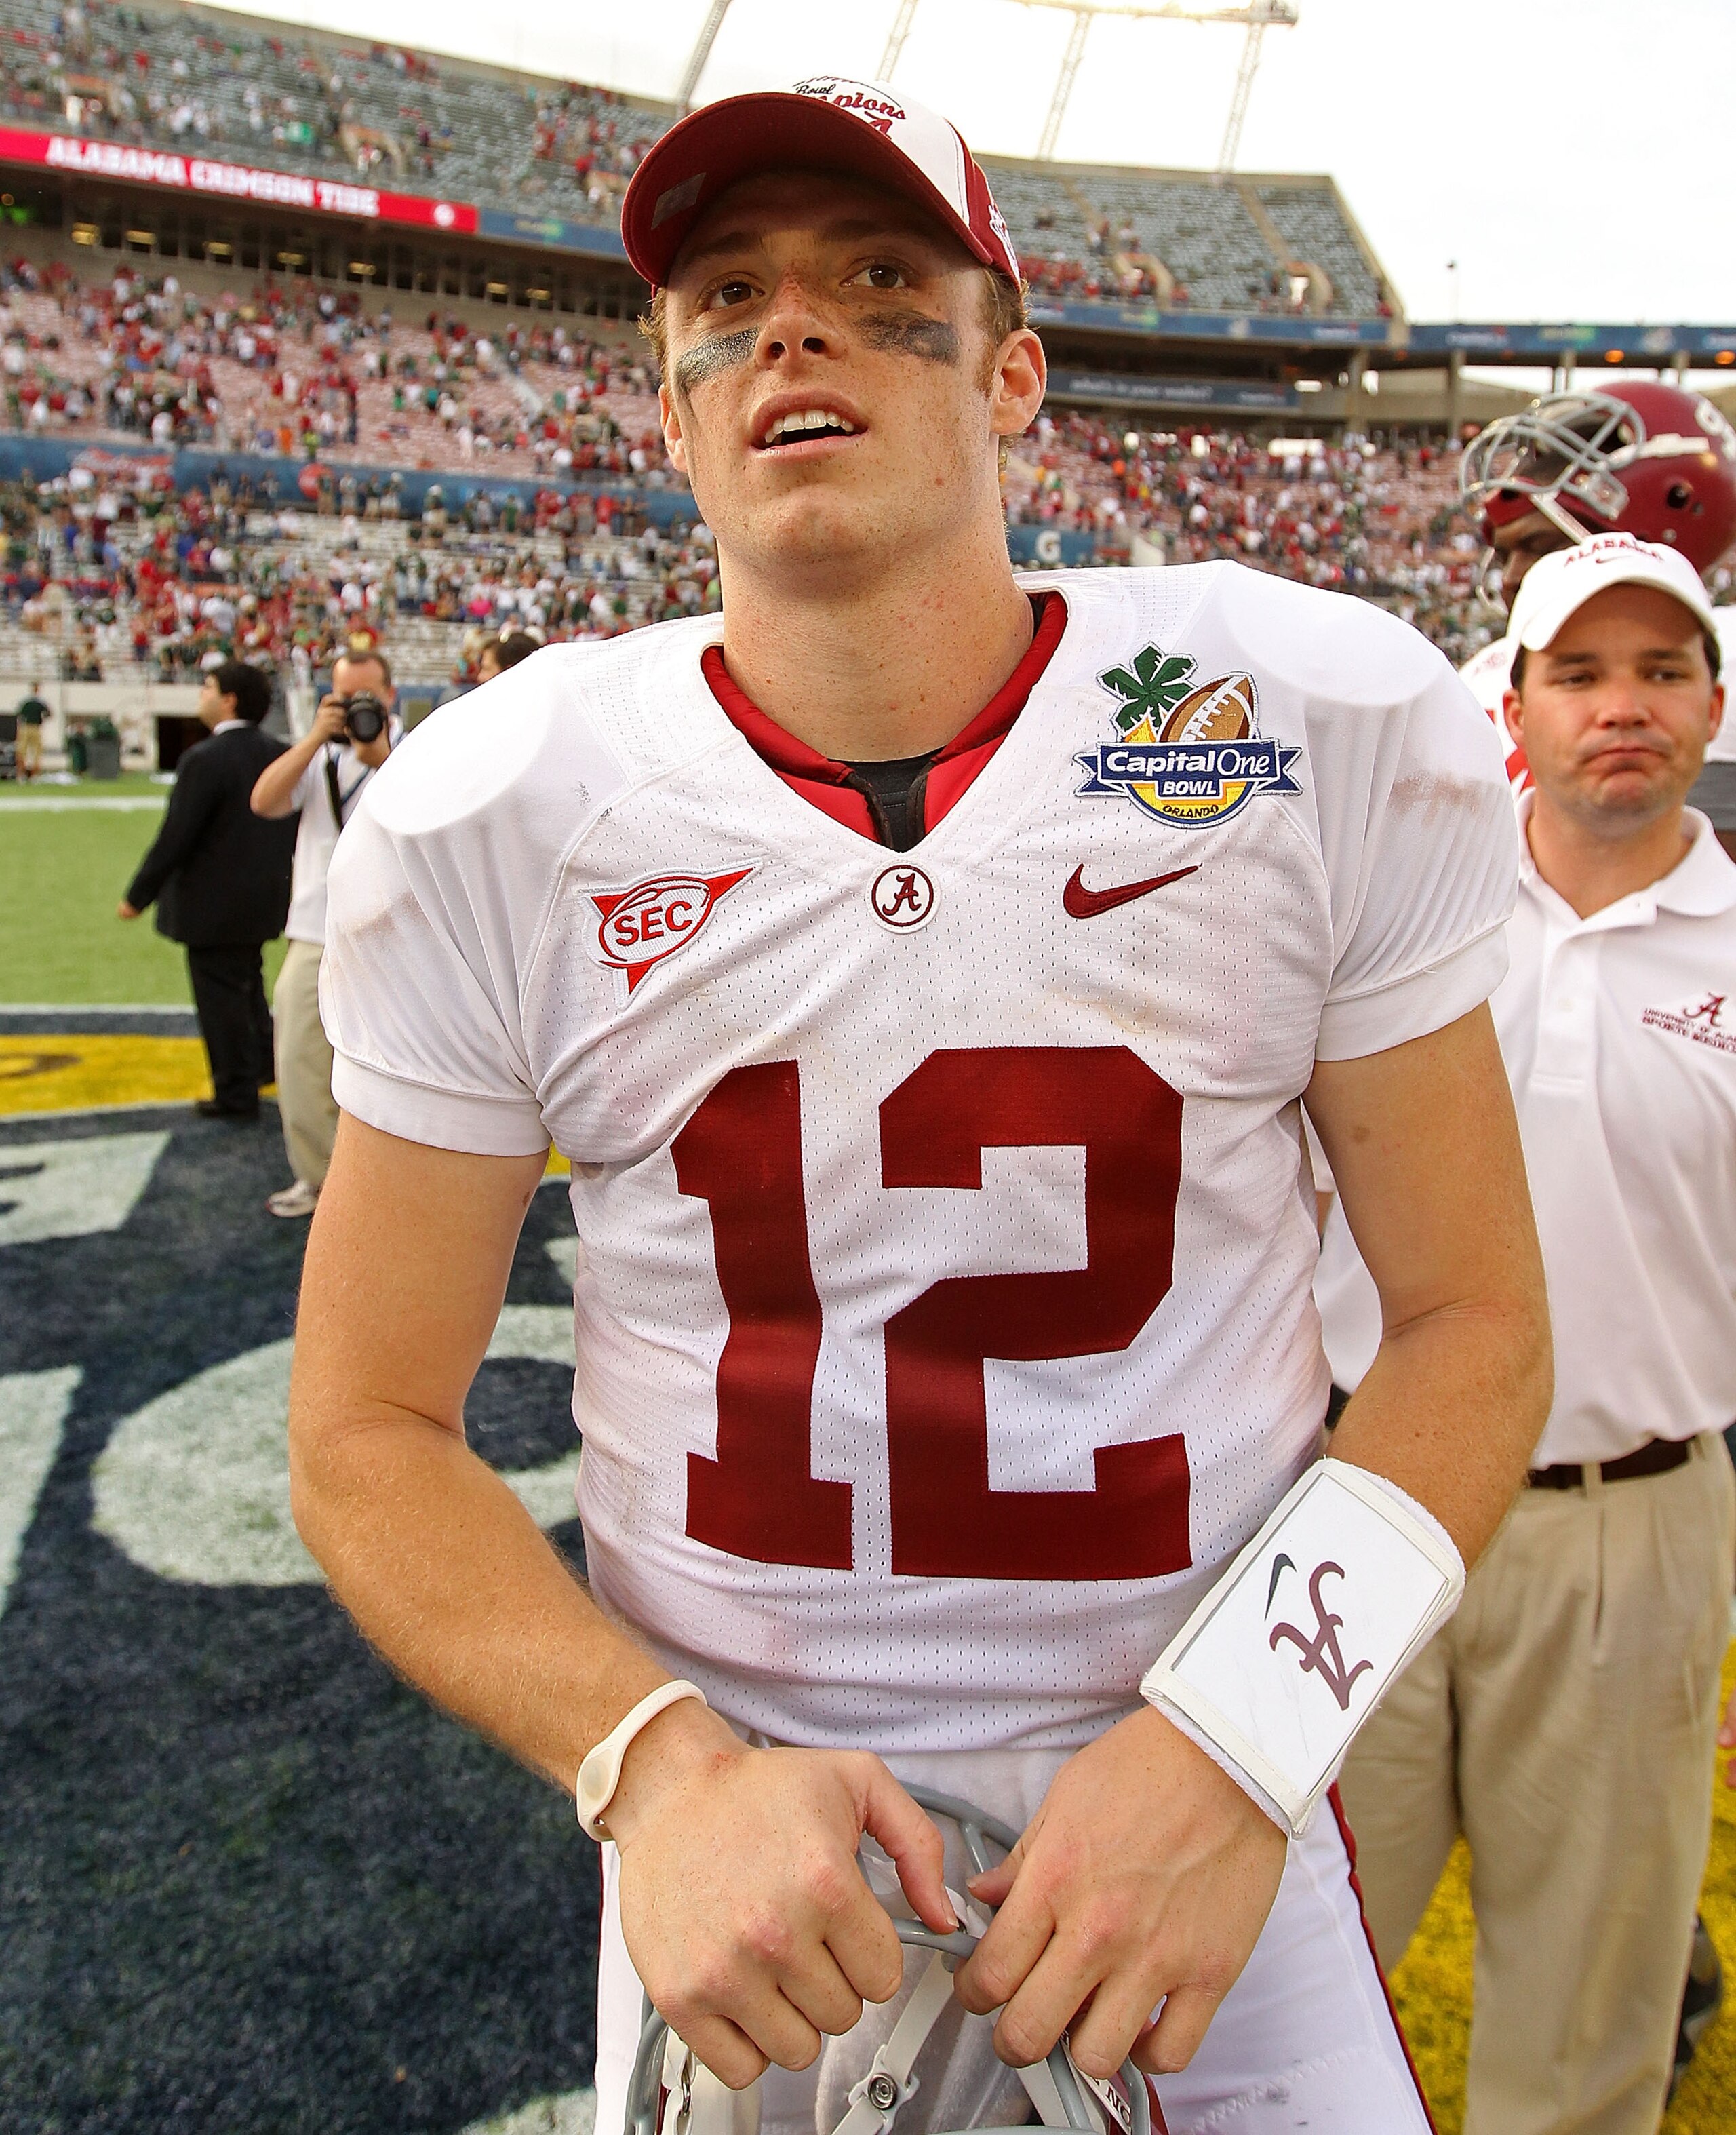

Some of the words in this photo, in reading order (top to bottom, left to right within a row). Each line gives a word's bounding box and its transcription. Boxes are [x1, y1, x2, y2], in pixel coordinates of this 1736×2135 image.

[795, 84, 837, 95] Bowl
[45, 136, 188, 187] ALABAMA
[189, 159, 315, 208] CRIMSON
[316, 180, 380, 218] TIDE
[1162, 781, 1217, 796] BOWL
[1162, 804, 1219, 819] ORLANDO
[882, 873, 922, 916] A
[614, 901, 692, 946] SEC
[1683, 992, 1726, 1027] A
[669, 1045, 1194, 1582] 12
